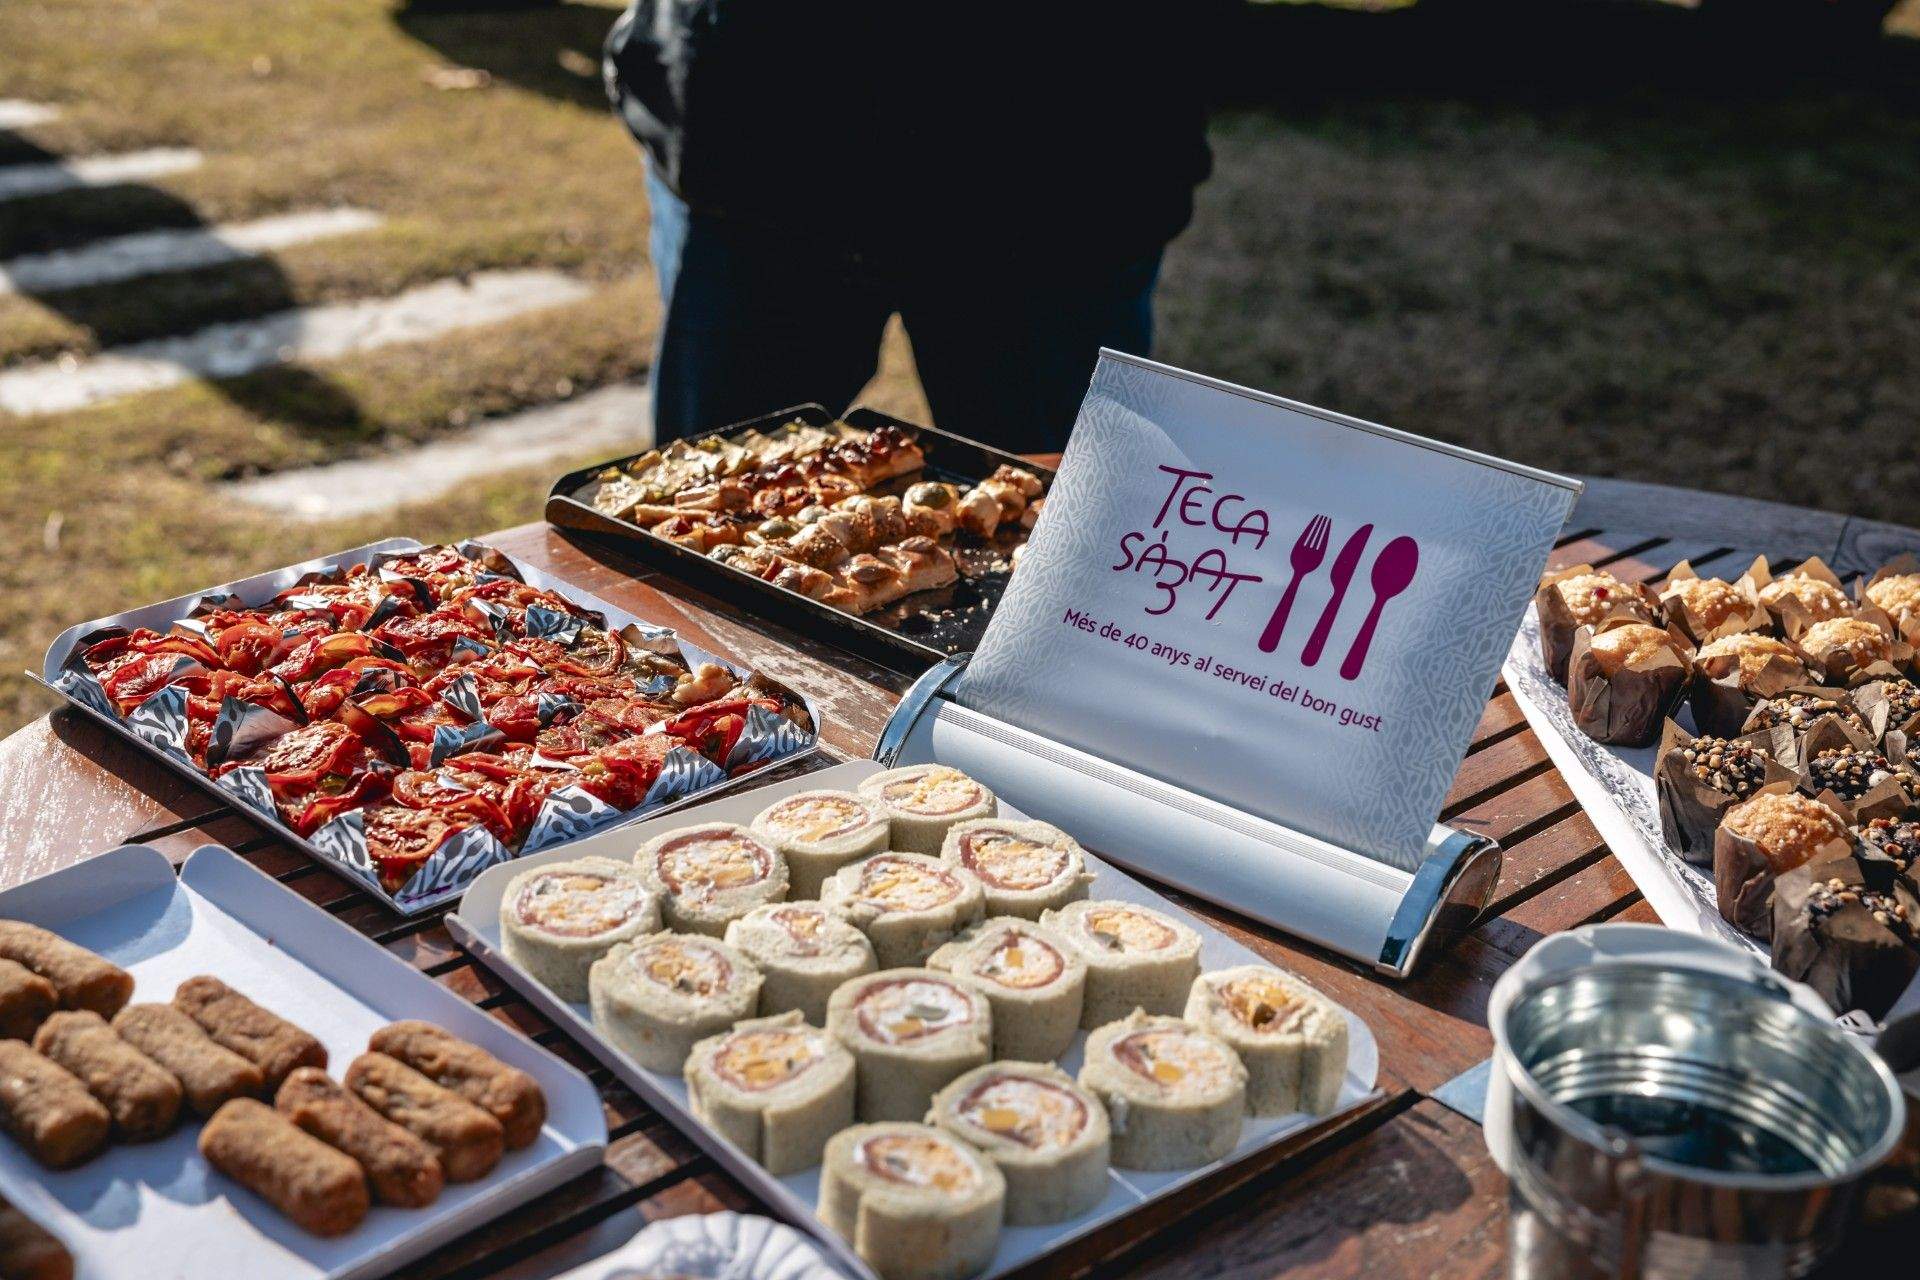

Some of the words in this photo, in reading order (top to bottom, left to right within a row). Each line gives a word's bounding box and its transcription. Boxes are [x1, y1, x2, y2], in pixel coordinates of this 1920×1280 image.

[1152, 464, 1270, 549] TECA
[1063, 608, 1096, 634] Més
[1099, 622, 1122, 642] de
[1124, 632, 1149, 650] 40
[1151, 643, 1191, 666] anys
[1194, 656, 1212, 672] al
[1213, 664, 1266, 692] servei
[1269, 681, 1300, 703] del
[1301, 689, 1336, 716] bon
[1339, 708, 1384, 732] gust
